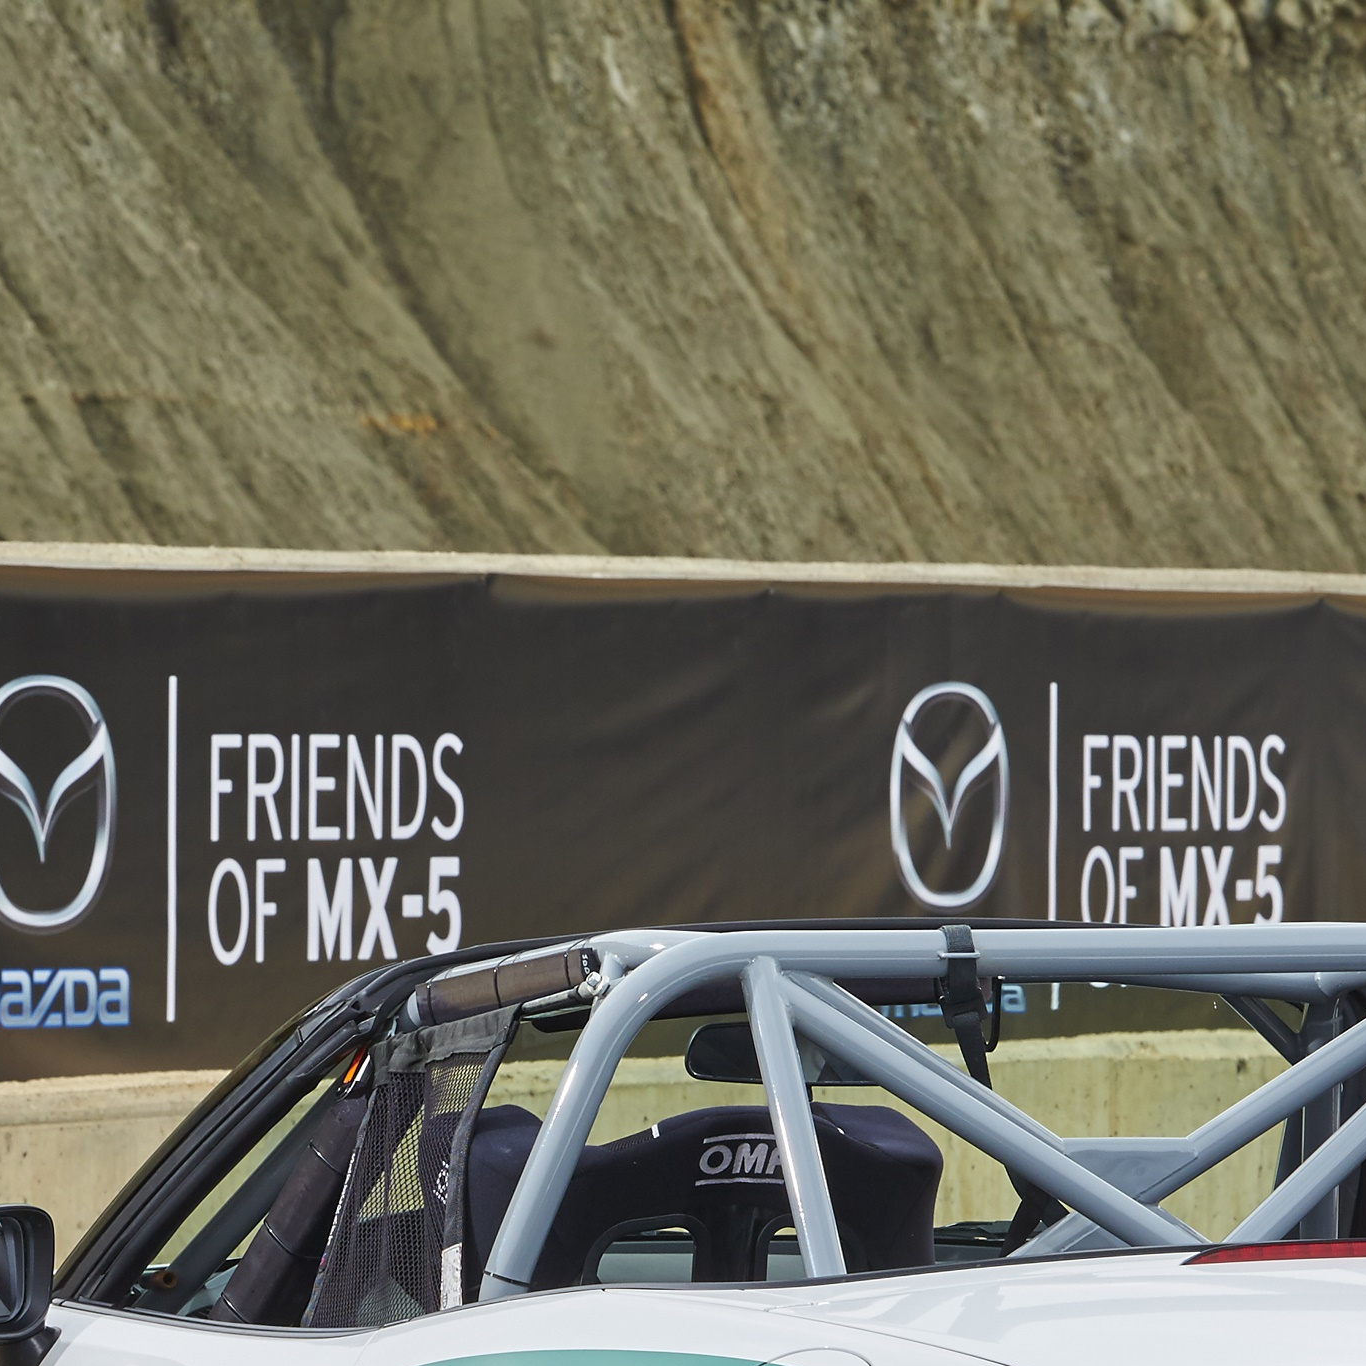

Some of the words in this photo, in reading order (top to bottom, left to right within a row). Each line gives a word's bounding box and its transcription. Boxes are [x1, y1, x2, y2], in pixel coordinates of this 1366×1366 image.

[210, 732, 465, 842] FRIENDS
[1082, 734, 1287, 833] FRIENDS
[208, 857, 287, 966] OF
[307, 856, 463, 962] MX-5
[1081, 845, 1145, 925] OF
[1159, 844, 1284, 928] MX-5
